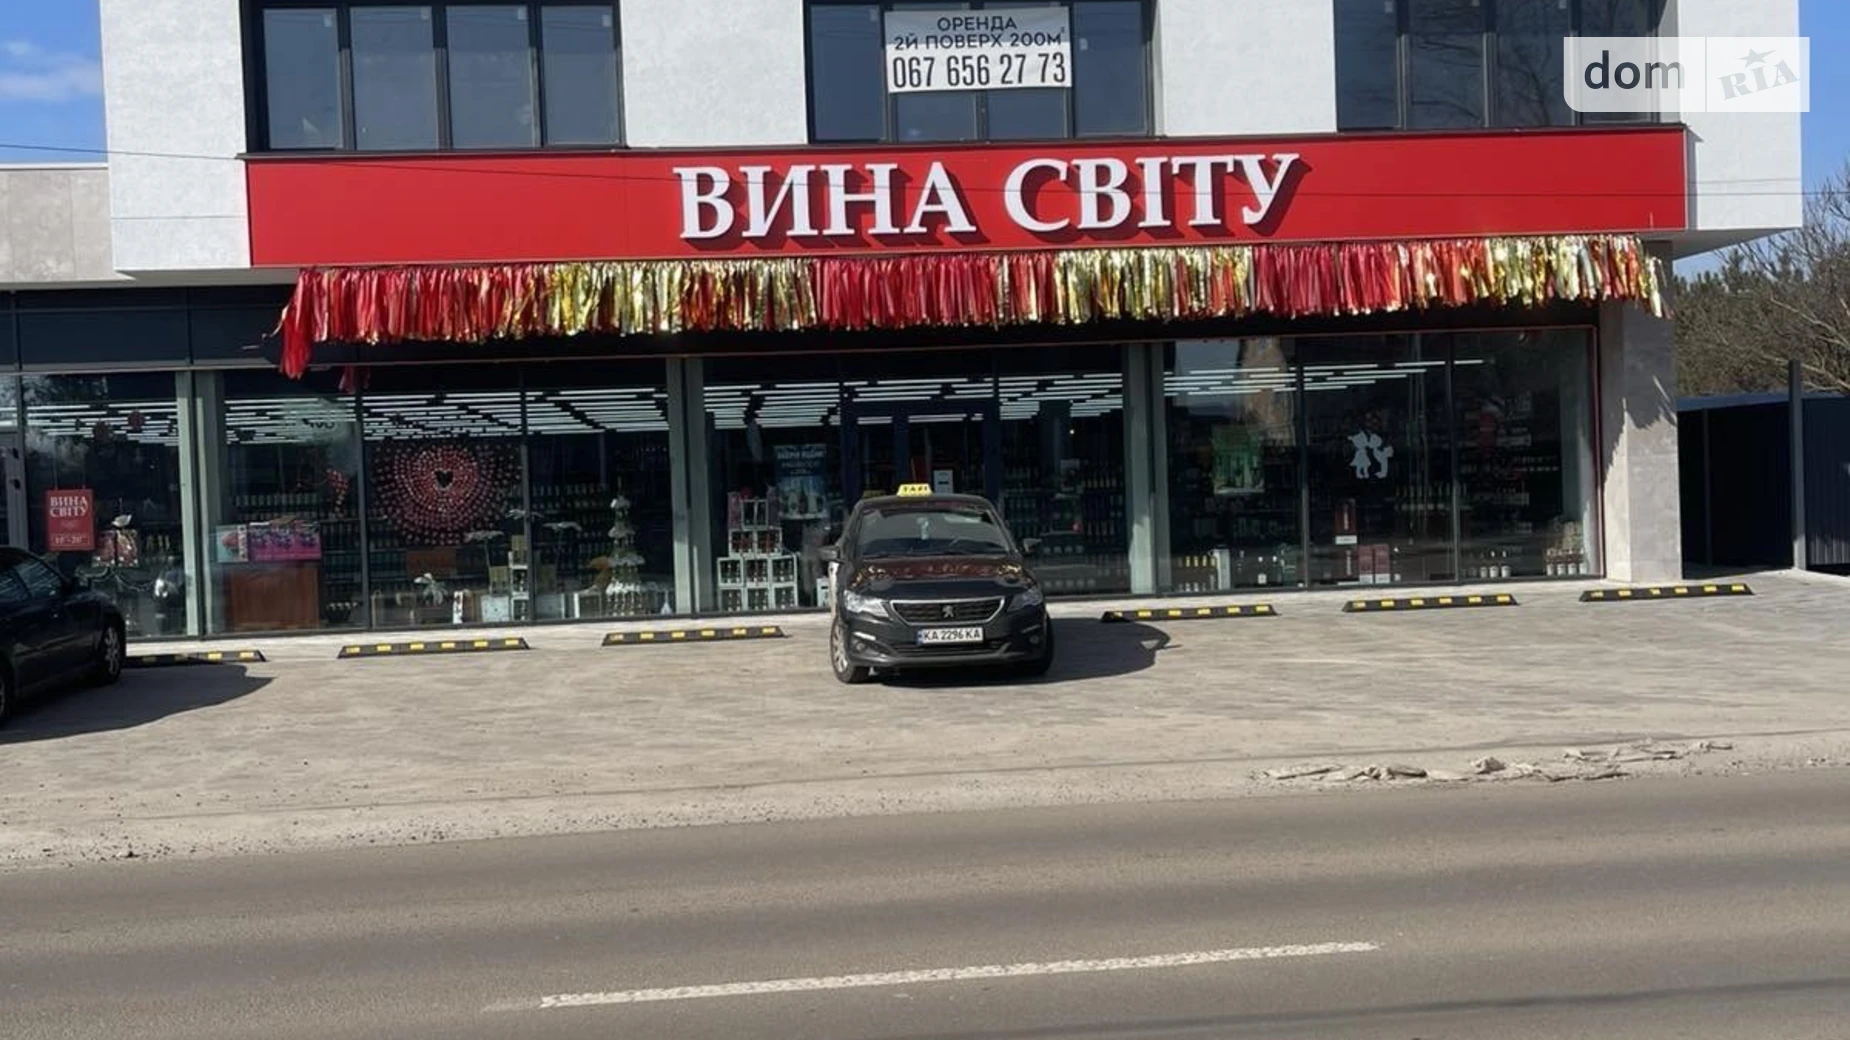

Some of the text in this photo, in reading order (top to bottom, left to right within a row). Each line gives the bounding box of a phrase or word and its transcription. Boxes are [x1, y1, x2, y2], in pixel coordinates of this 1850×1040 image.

[937, 15, 1018, 32] ОРЕНДА
[925, 33, 1003, 50] ПОВЕРХ
[893, 52, 1066, 88] 067 656 27 73
[672, 153, 1300, 240] ВИНА СВІТУ
[903, 485, 928, 493] TAXI
[50, 496, 88, 508] ВИНА
[50, 507, 87, 518] СВІТУ
[924, 628, 981, 640] KA 2296 KA
